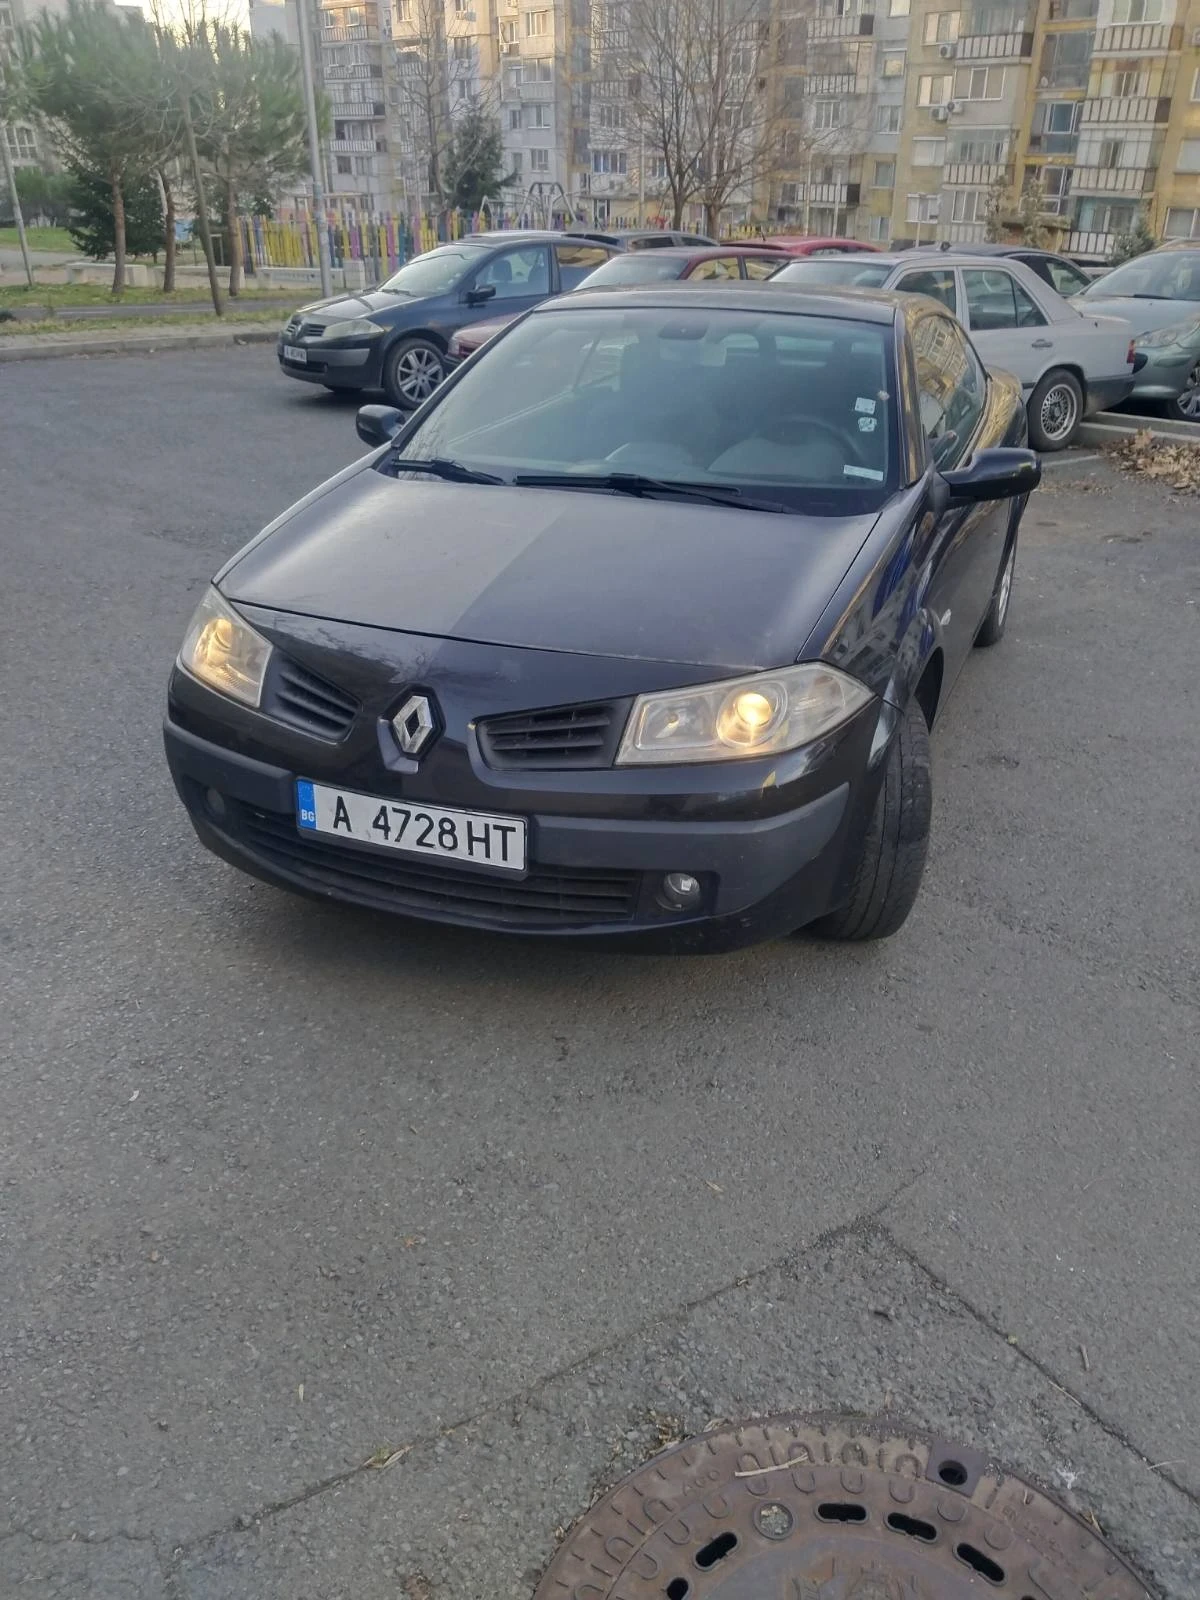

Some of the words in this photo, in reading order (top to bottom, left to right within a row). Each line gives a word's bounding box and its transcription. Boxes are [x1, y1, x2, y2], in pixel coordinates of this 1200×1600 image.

[301, 809, 315, 822] BG
[333, 796, 352, 832] A
[372, 805, 459, 851] 4728
